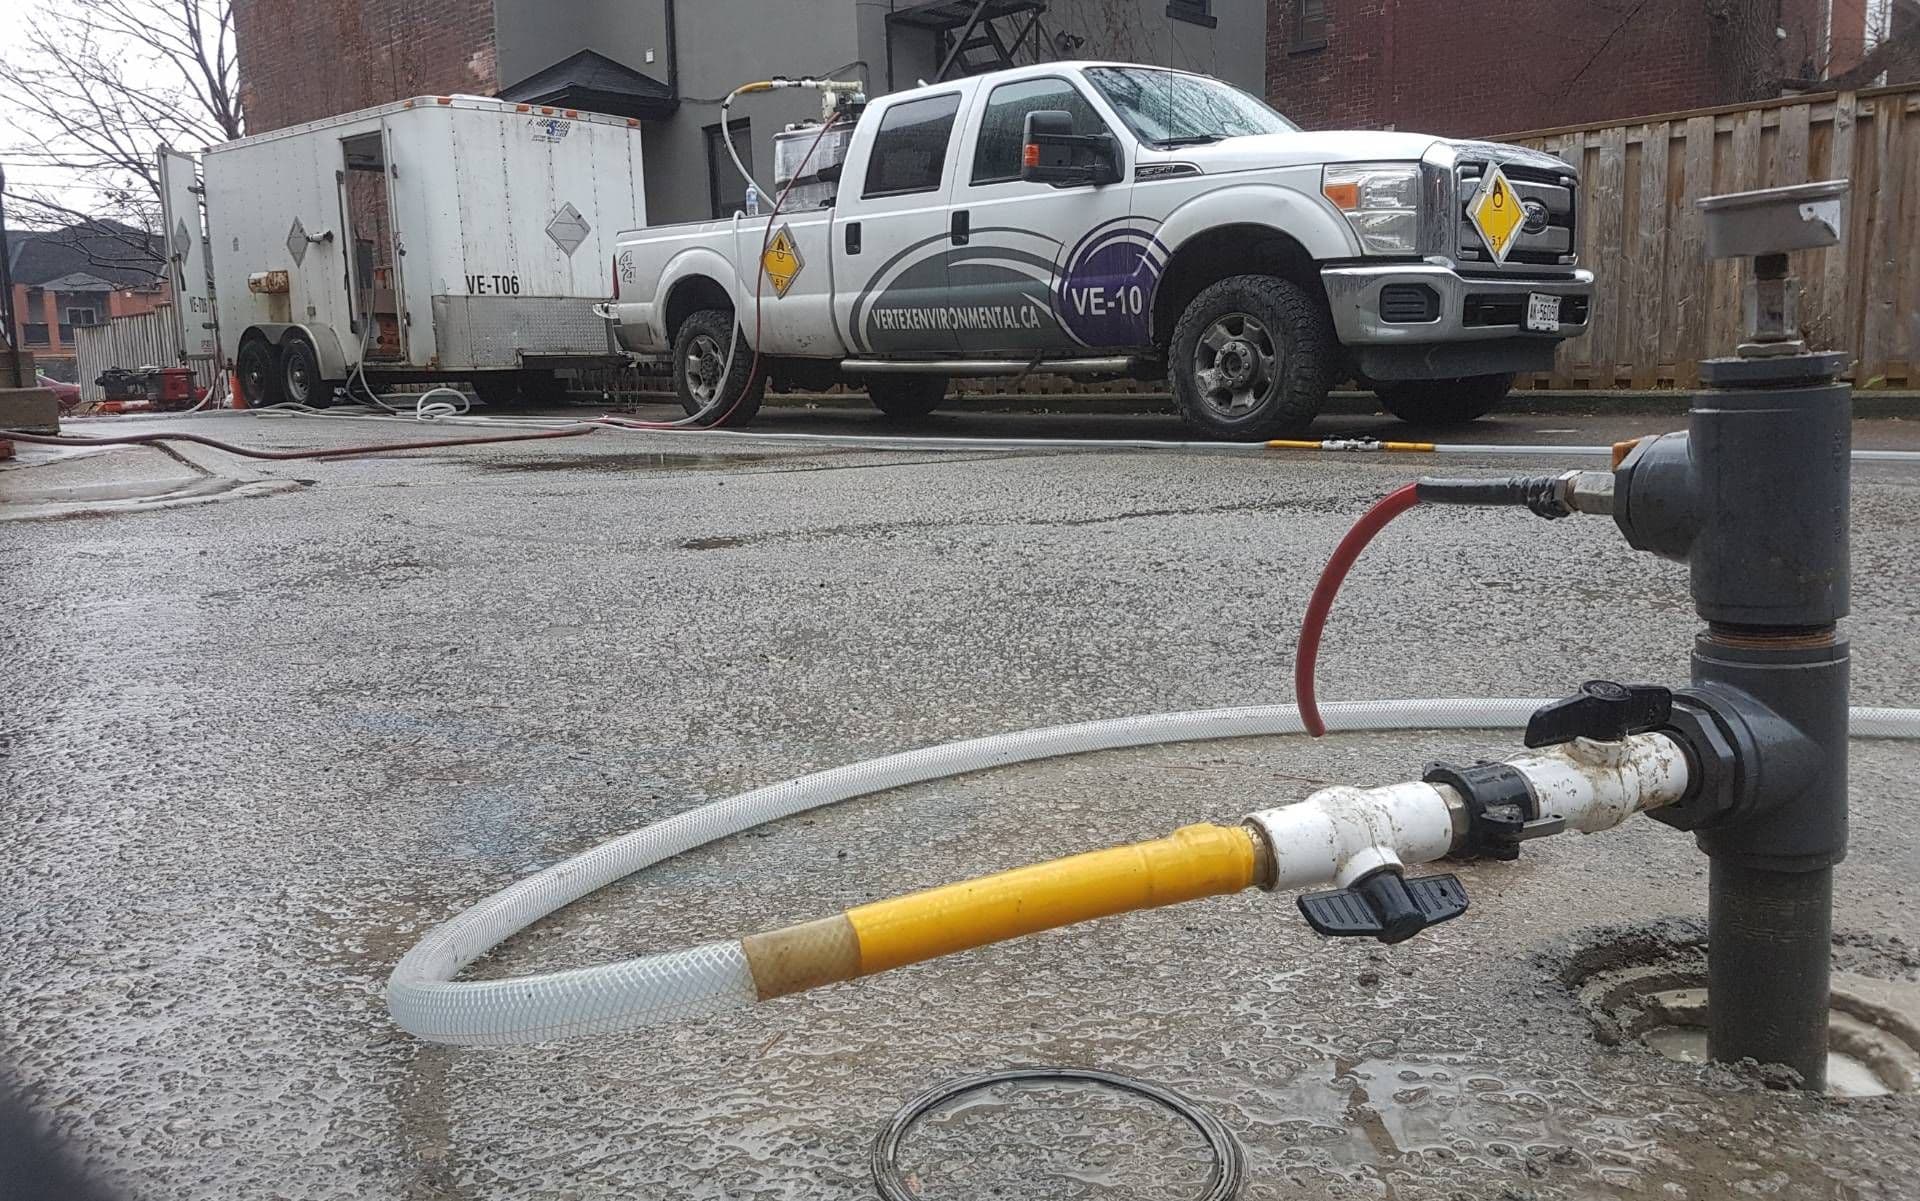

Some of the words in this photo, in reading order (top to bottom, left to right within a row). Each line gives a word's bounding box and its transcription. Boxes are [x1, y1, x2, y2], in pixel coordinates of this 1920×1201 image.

[465, 275, 520, 295] VE-T06
[1071, 286, 1142, 316] VE-10
[872, 306, 1041, 331] VERTEXENVIRONMENTAL.CA
